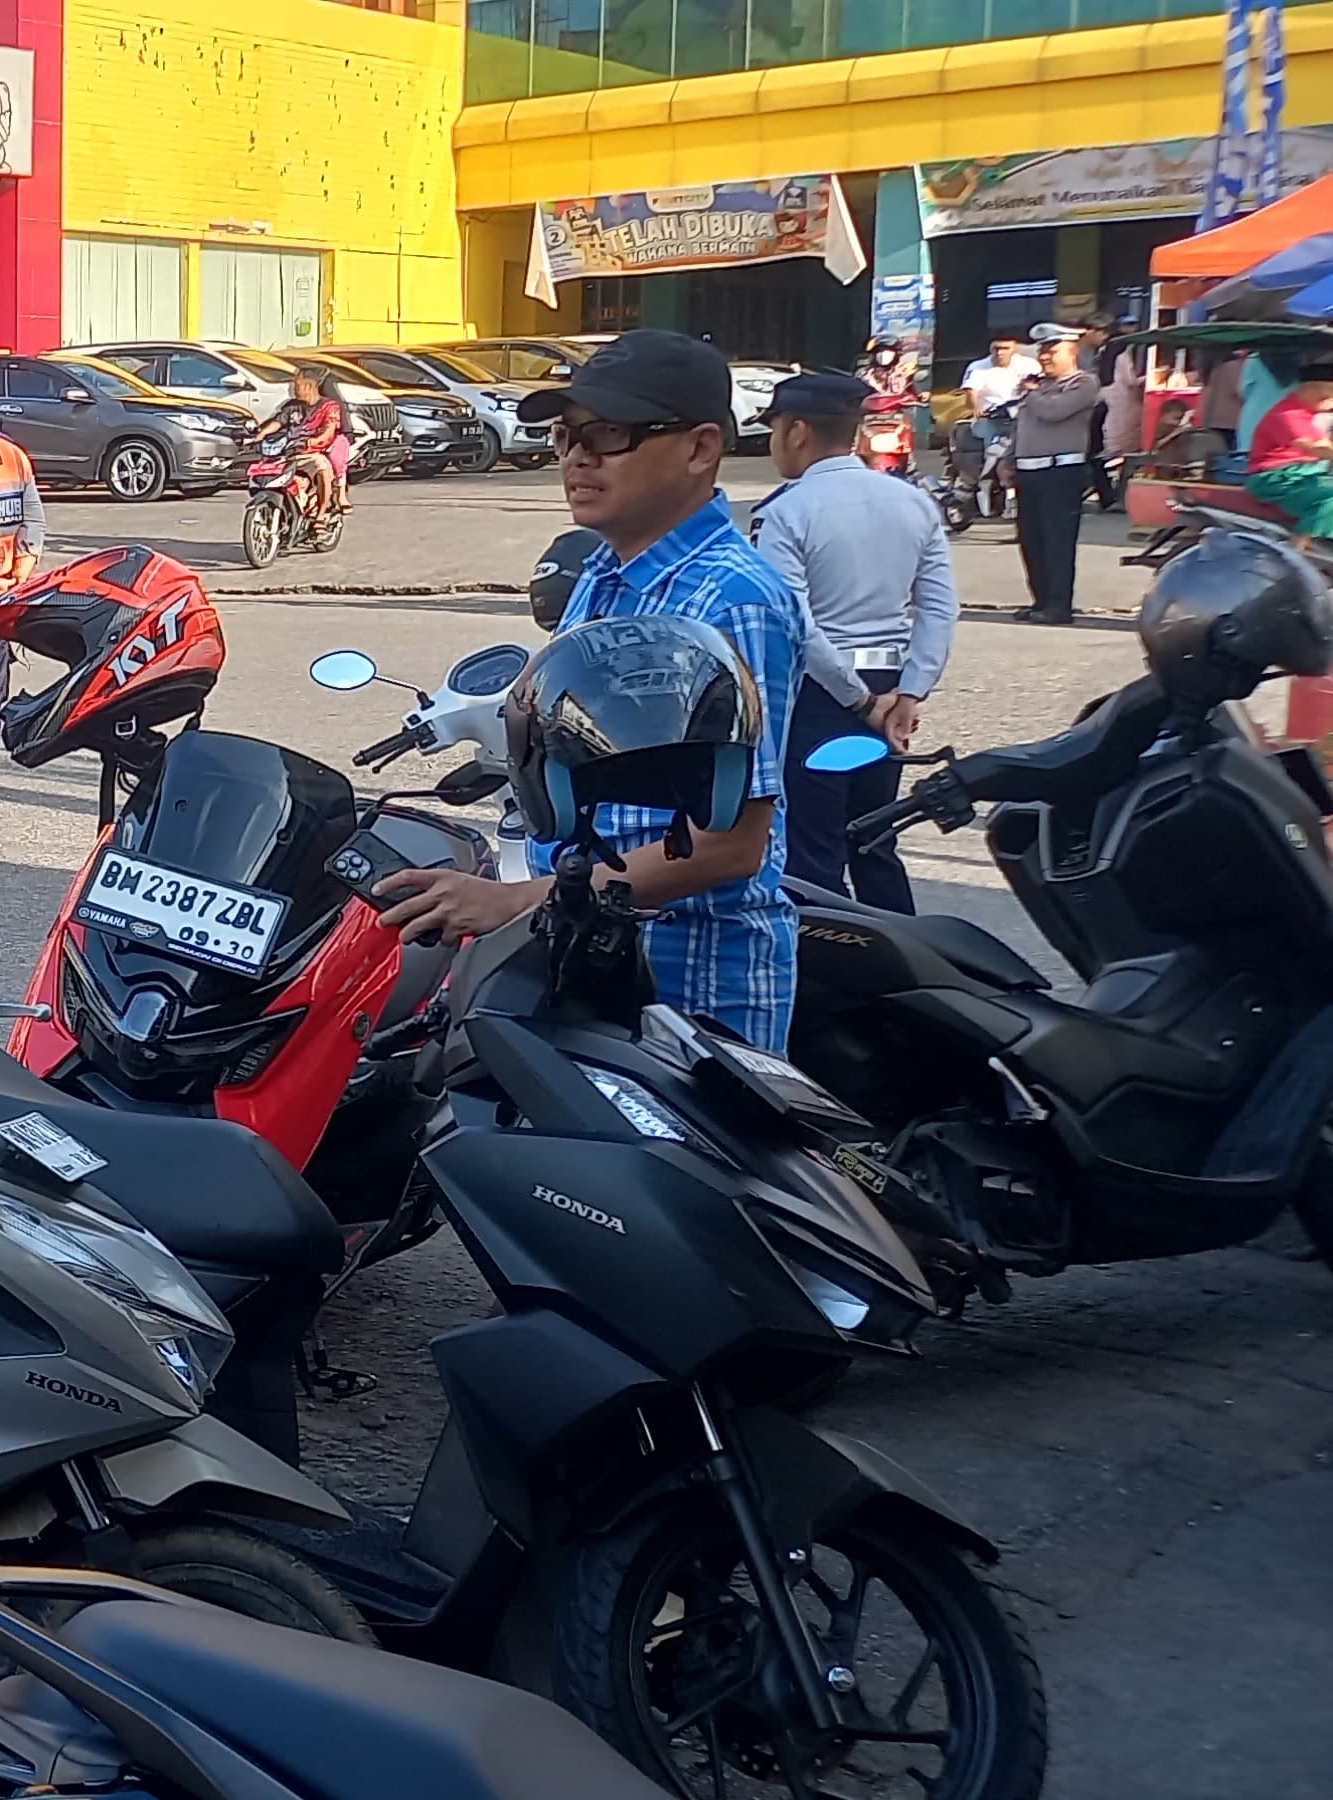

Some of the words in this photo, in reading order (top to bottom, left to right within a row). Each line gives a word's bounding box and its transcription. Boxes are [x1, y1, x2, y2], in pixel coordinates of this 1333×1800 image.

[602, 213, 680, 252] TELAH
[686, 211, 775, 240] DIBUKA
[628, 244, 686, 265] WAHANA
[691, 239, 757, 256] BERMAIN
[107, 591, 194, 687] KYT
[88, 910, 126, 929] YAMAHA
[100, 860, 143, 895] BM
[142, 875, 217, 918] 2387
[215, 897, 265, 936] ZBL
[532, 1184, 626, 1234] HONDA
[25, 1370, 123, 1413] HONDA
